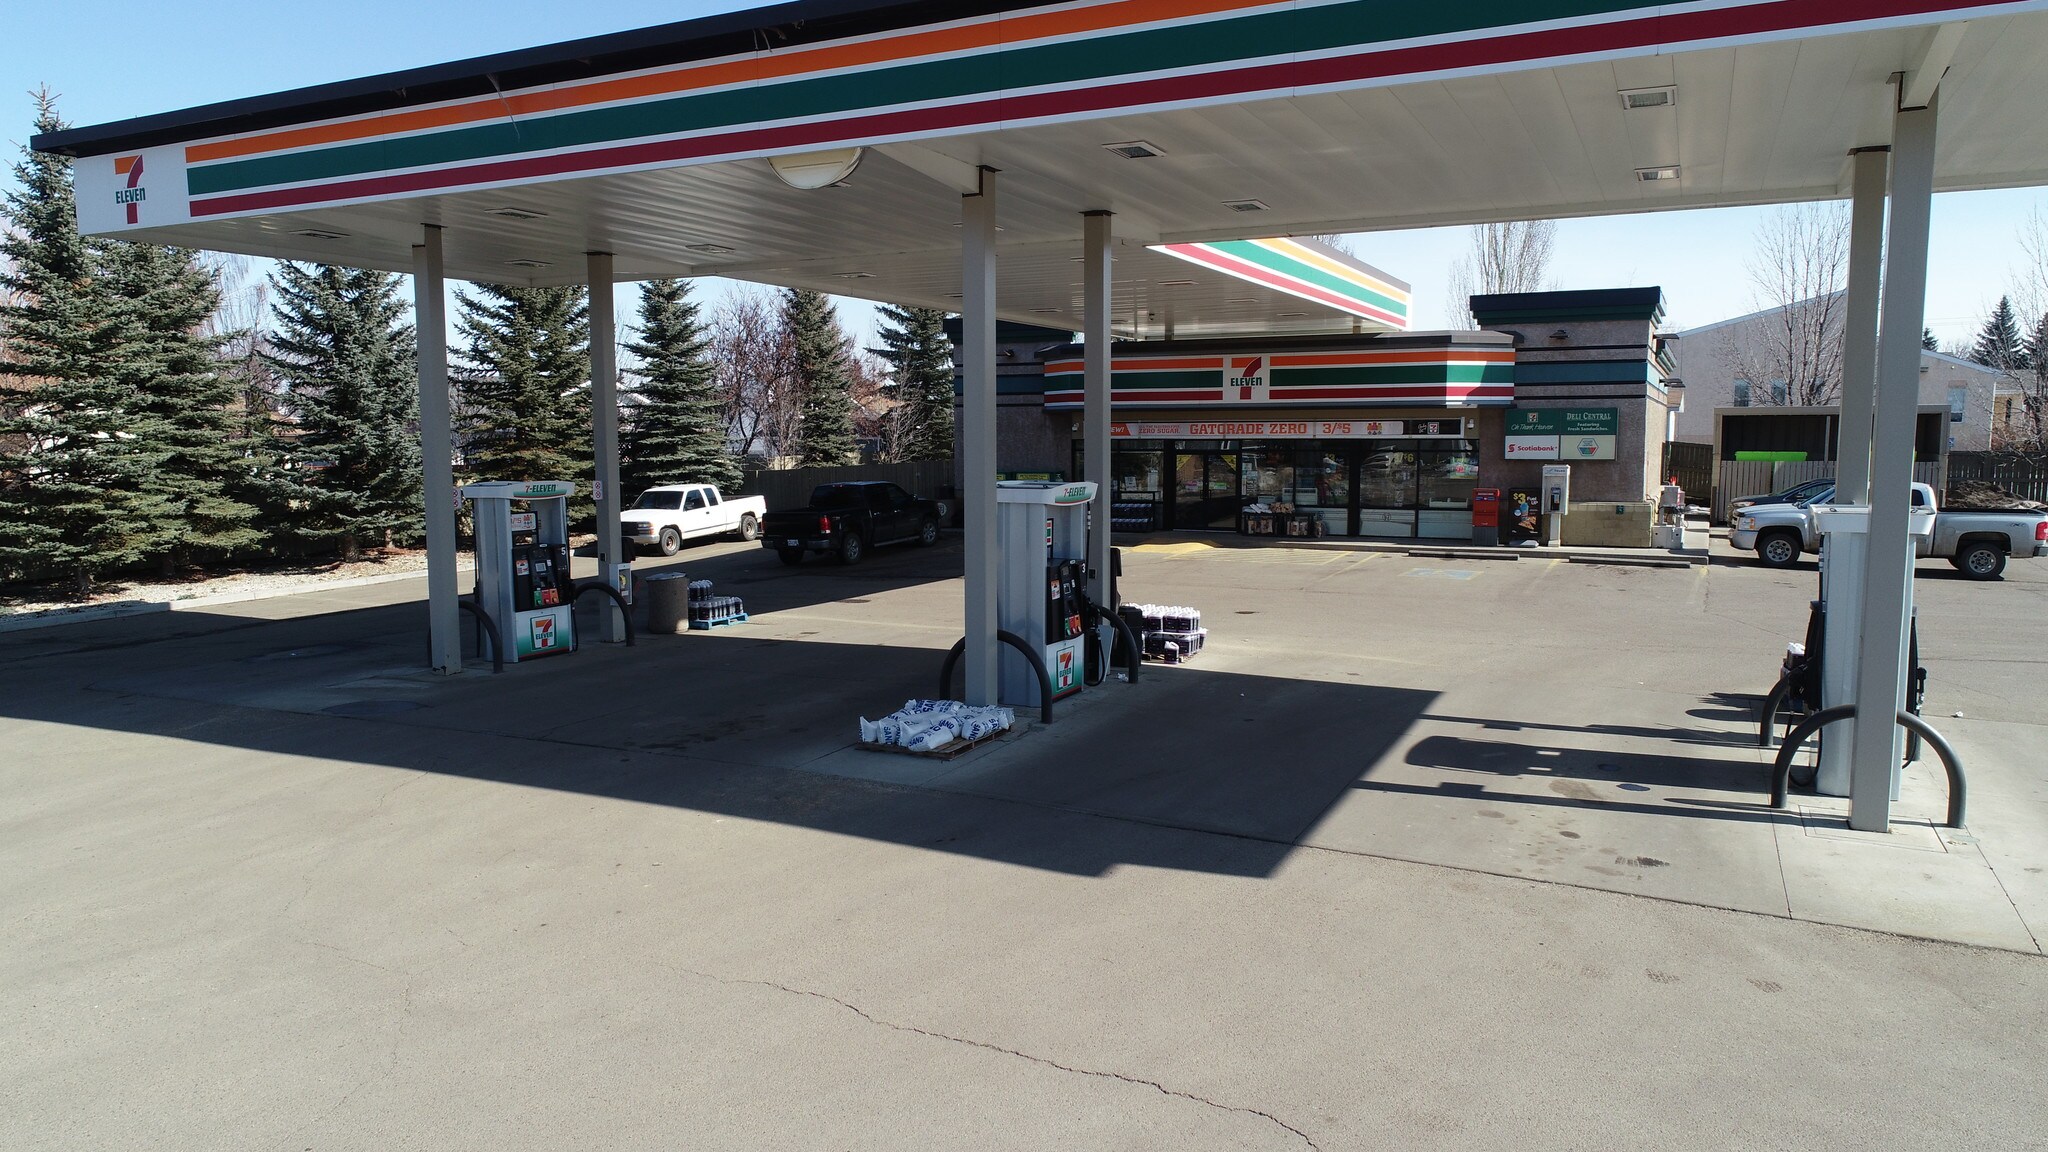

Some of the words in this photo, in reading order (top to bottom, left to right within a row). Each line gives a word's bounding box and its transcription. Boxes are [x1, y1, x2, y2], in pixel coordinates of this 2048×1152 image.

[114, 154, 144, 224] 7
[1231, 356, 1262, 399] 7
[1189, 423, 1264, 435] GATORADE
[1269, 423, 1307, 434] ZERO
[1512, 492, 1526, 504] $3
[561, 546, 566, 556] 5
[1081, 563, 1086, 573] 3
[535, 619, 553, 648] 7
[1059, 651, 1072, 687] 7
[938, 719, 955, 730] SAND
[968, 723, 981, 741] SAND
[908, 736, 925, 747] SAND
